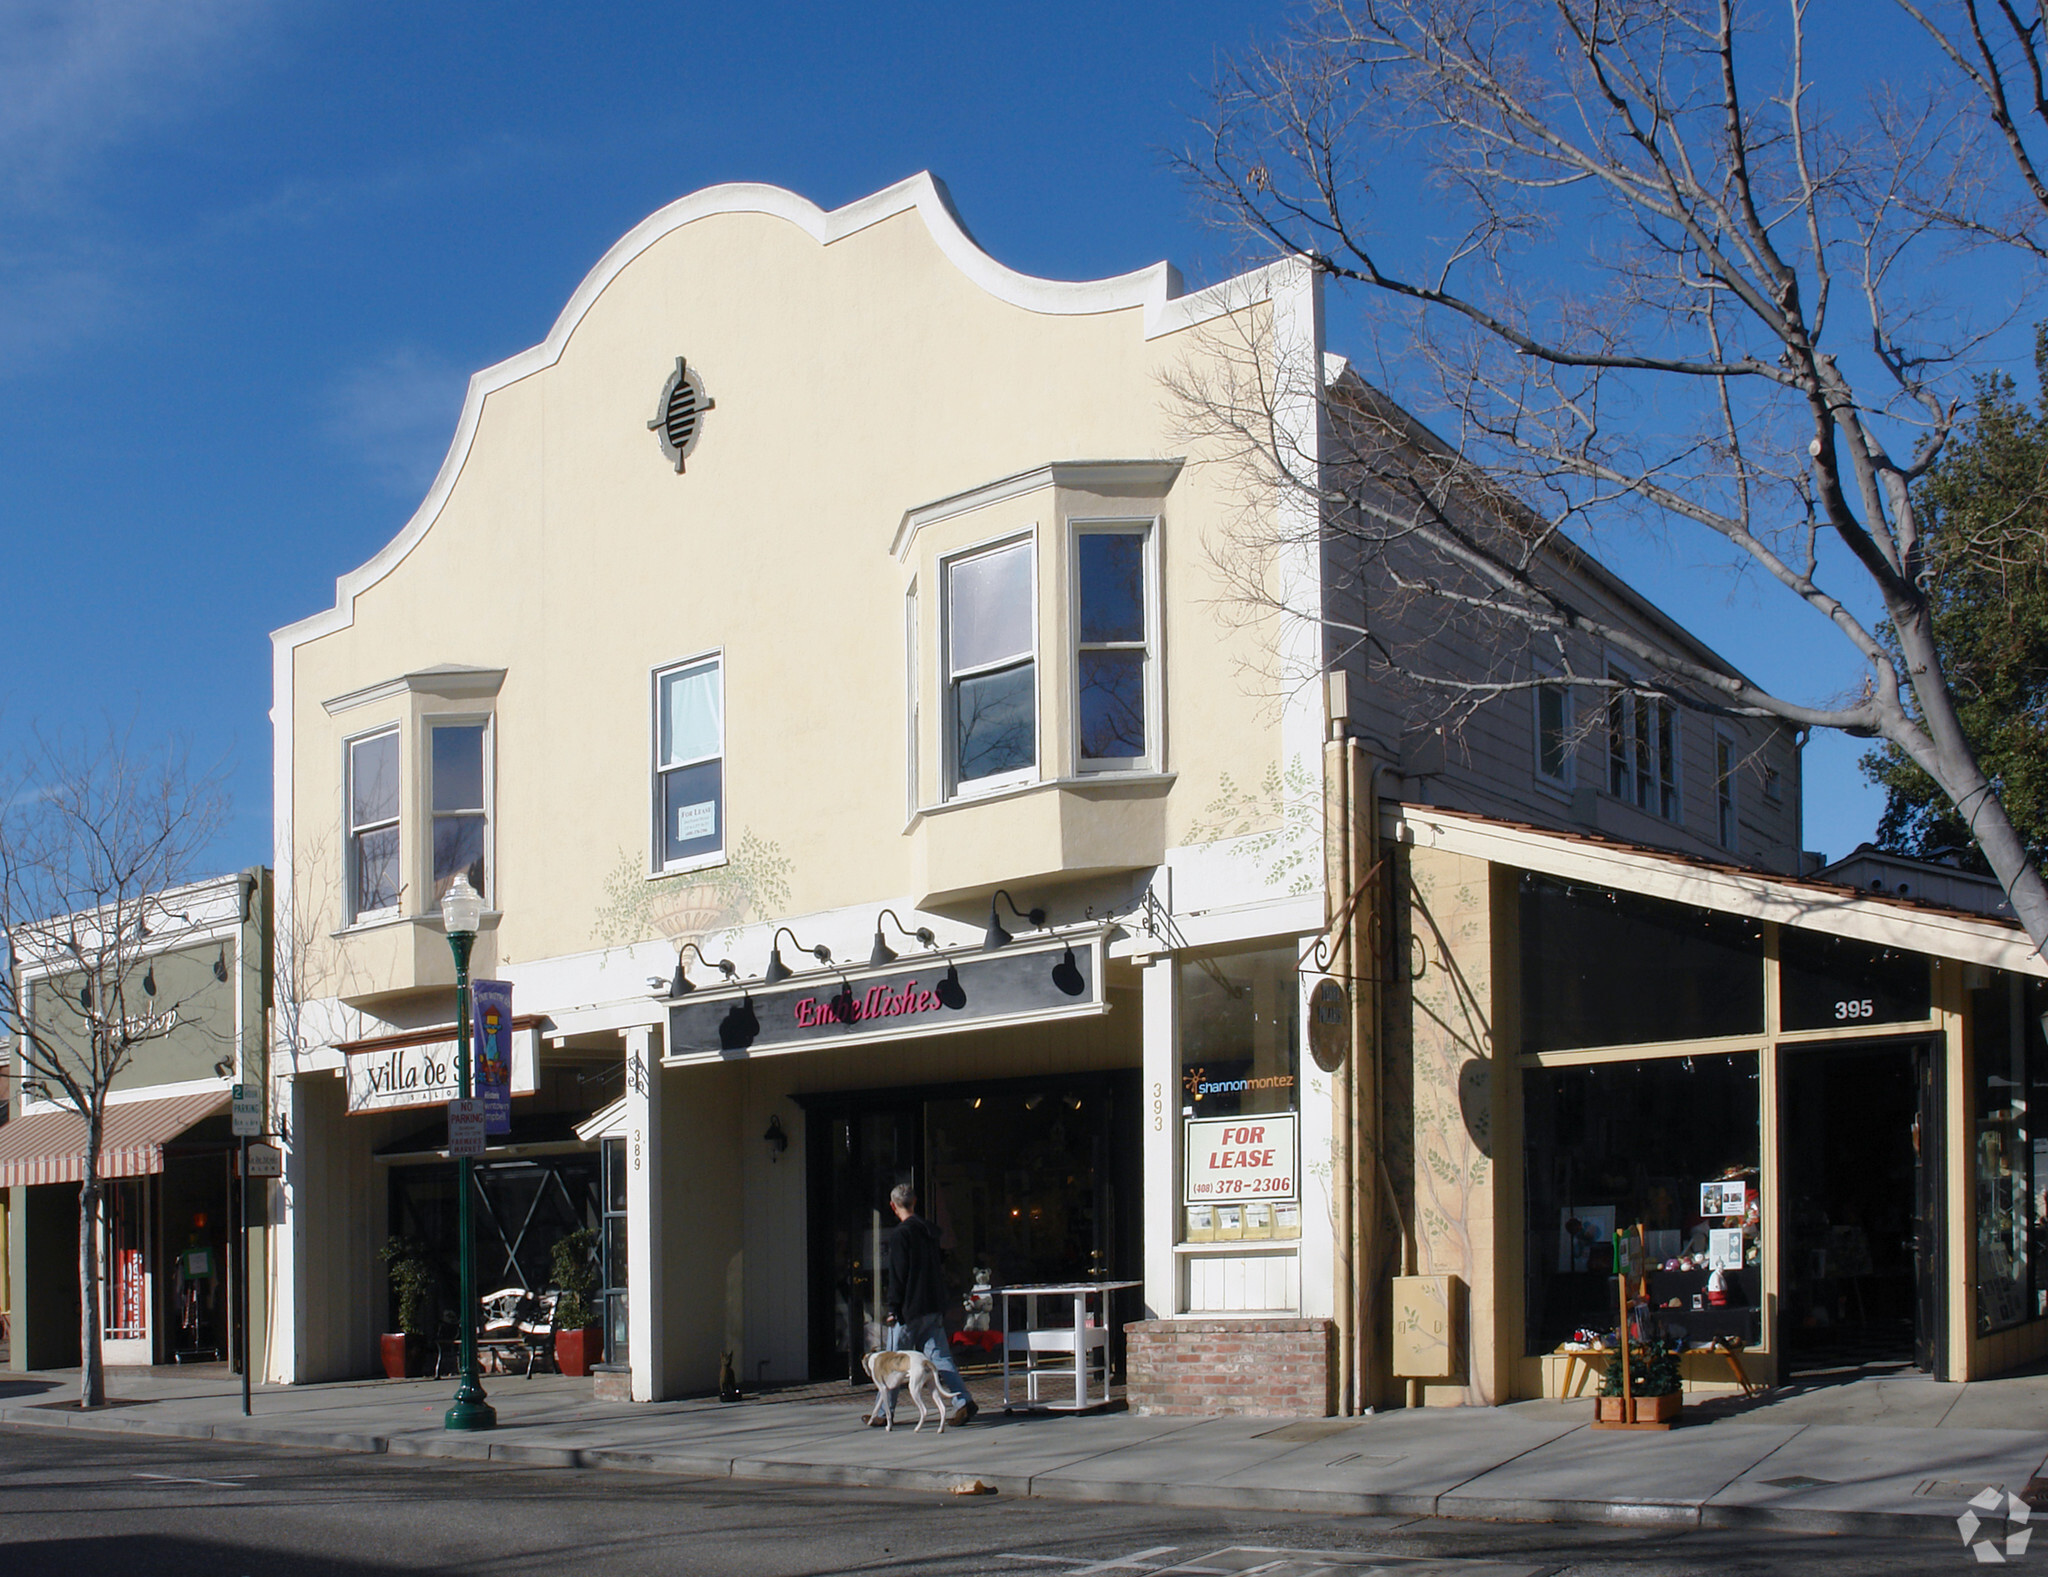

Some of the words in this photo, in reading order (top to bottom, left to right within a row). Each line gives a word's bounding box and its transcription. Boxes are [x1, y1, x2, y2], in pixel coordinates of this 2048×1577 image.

[793, 980, 943, 1028] Embellishes
[1834, 999, 1873, 1019] 395
[367, 1051, 418, 1092] Villa
[424, 1055, 446, 1085] de
[234, 1086, 242, 1098] 2
[1198, 1075, 1294, 1094] shannonmontez
[234, 1103, 258, 1114] PARKING
[460, 1101, 473, 1111] NO
[1153, 1083, 1163, 1131] 393
[451, 1113, 483, 1124] PARKING
[1221, 1126, 1265, 1145] FOR
[1209, 1149, 1276, 1169] LEASE
[1193, 1183, 1214, 1194] (408)
[1215, 1177, 1290, 1194] 378-2306
